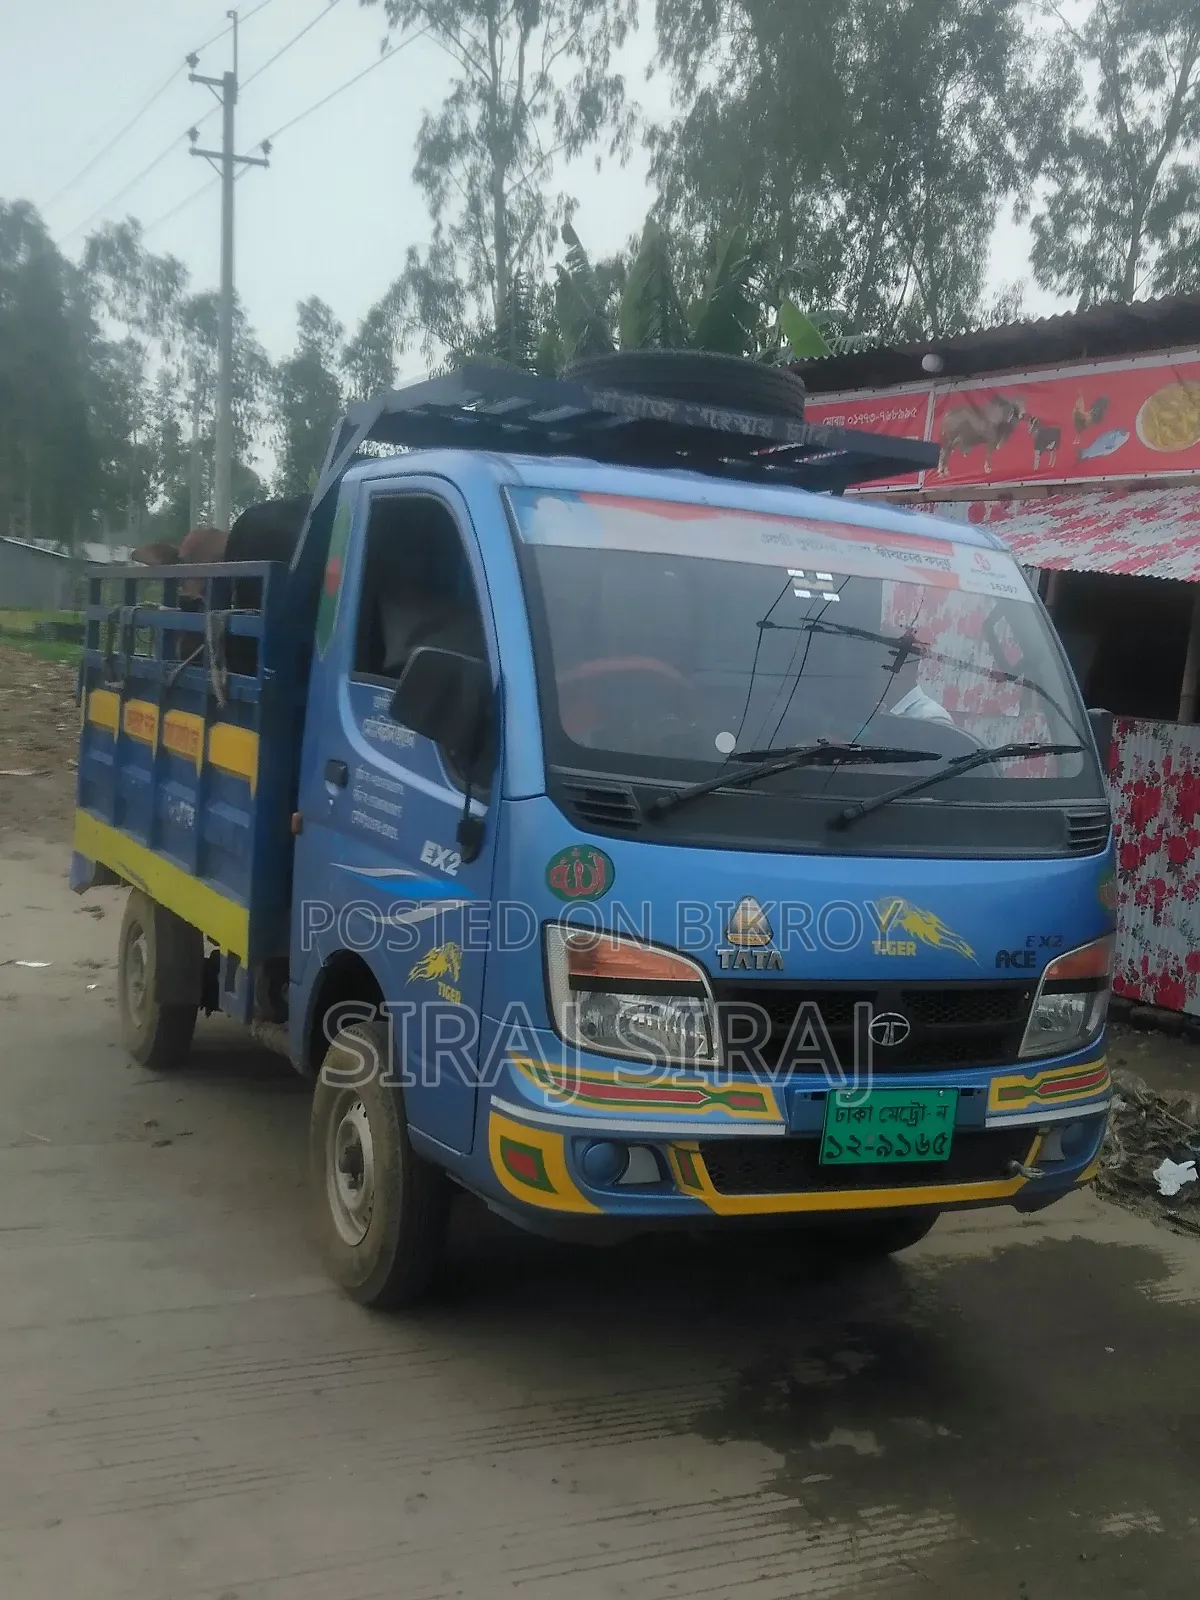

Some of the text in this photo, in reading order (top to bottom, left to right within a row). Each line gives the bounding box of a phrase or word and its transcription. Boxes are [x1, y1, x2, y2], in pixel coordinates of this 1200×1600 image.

[420, 840, 461, 876] EX2
[716, 949, 784, 971] TATA
[871, 941, 917, 957] TIGER
[995, 949, 1037, 969] ACE
[438, 981, 462, 1005] TIGER
[835, 1105, 873, 1124] ঢাকা
[825, 1132, 949, 1159] ১২-৯১৬৫
